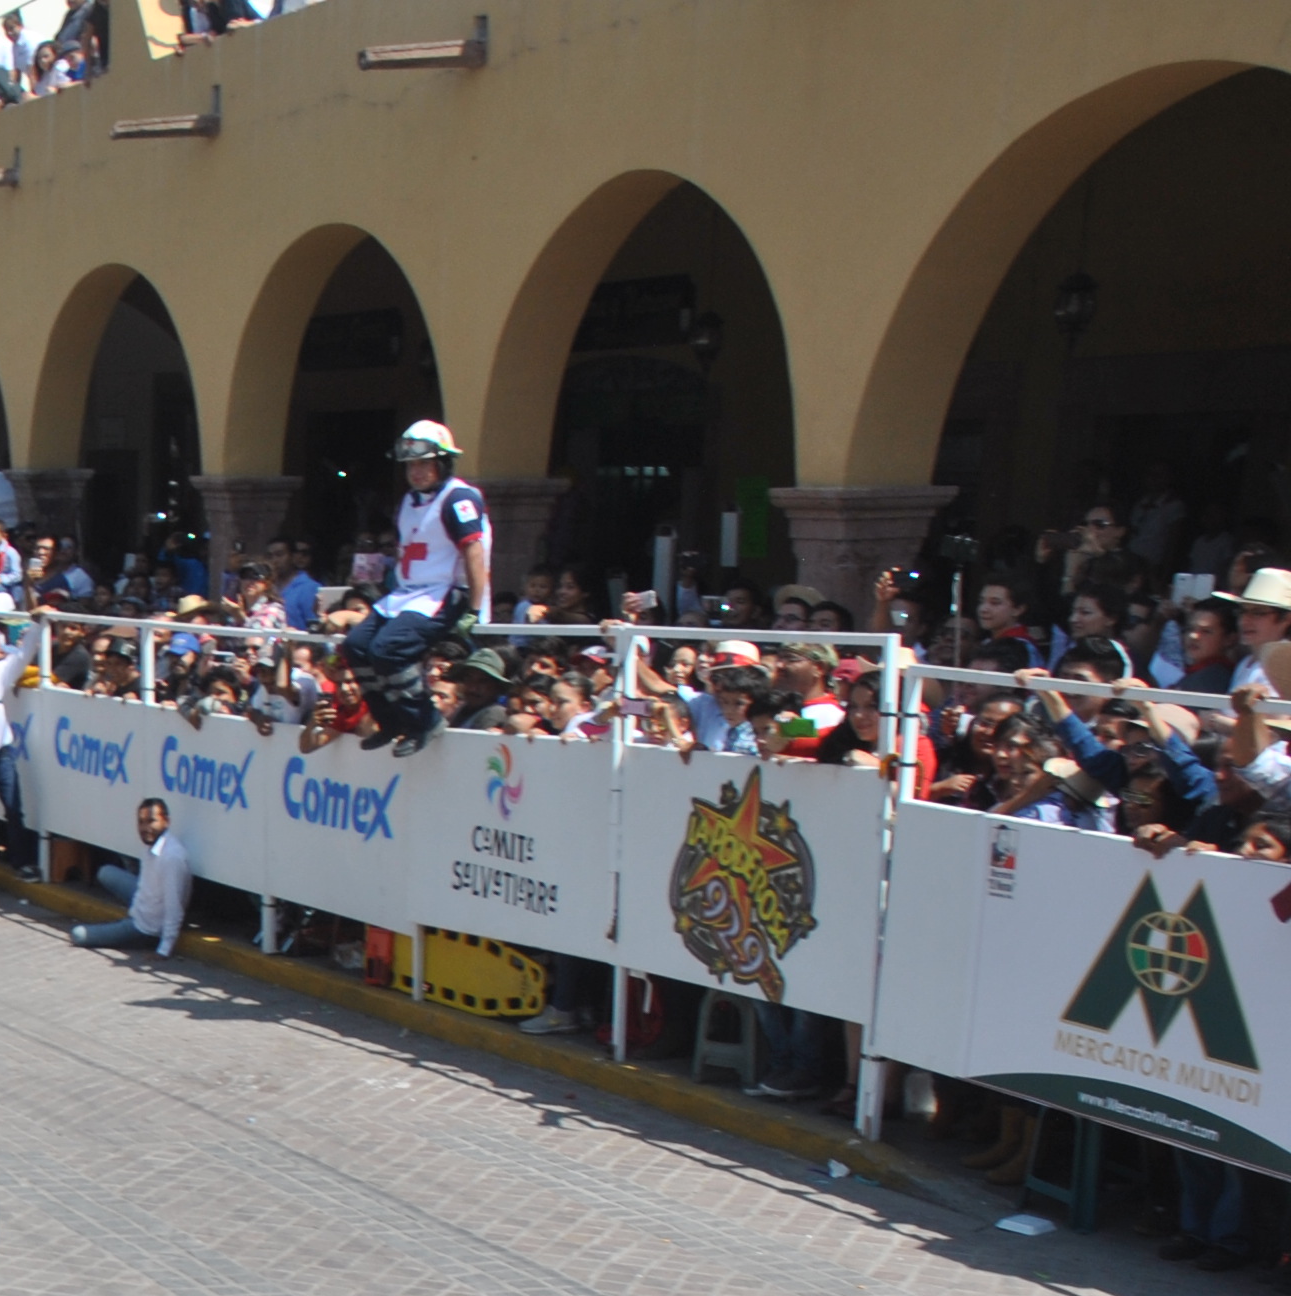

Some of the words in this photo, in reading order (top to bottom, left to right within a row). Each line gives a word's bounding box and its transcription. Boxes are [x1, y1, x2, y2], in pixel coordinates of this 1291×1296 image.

[55, 716, 134, 785] Comex
[161, 735, 255, 811] Comex
[283, 756, 401, 841] Comex
[1053, 1030, 1171, 1082] MERCATOR
[1175, 1062, 1262, 1107] MUNDI
